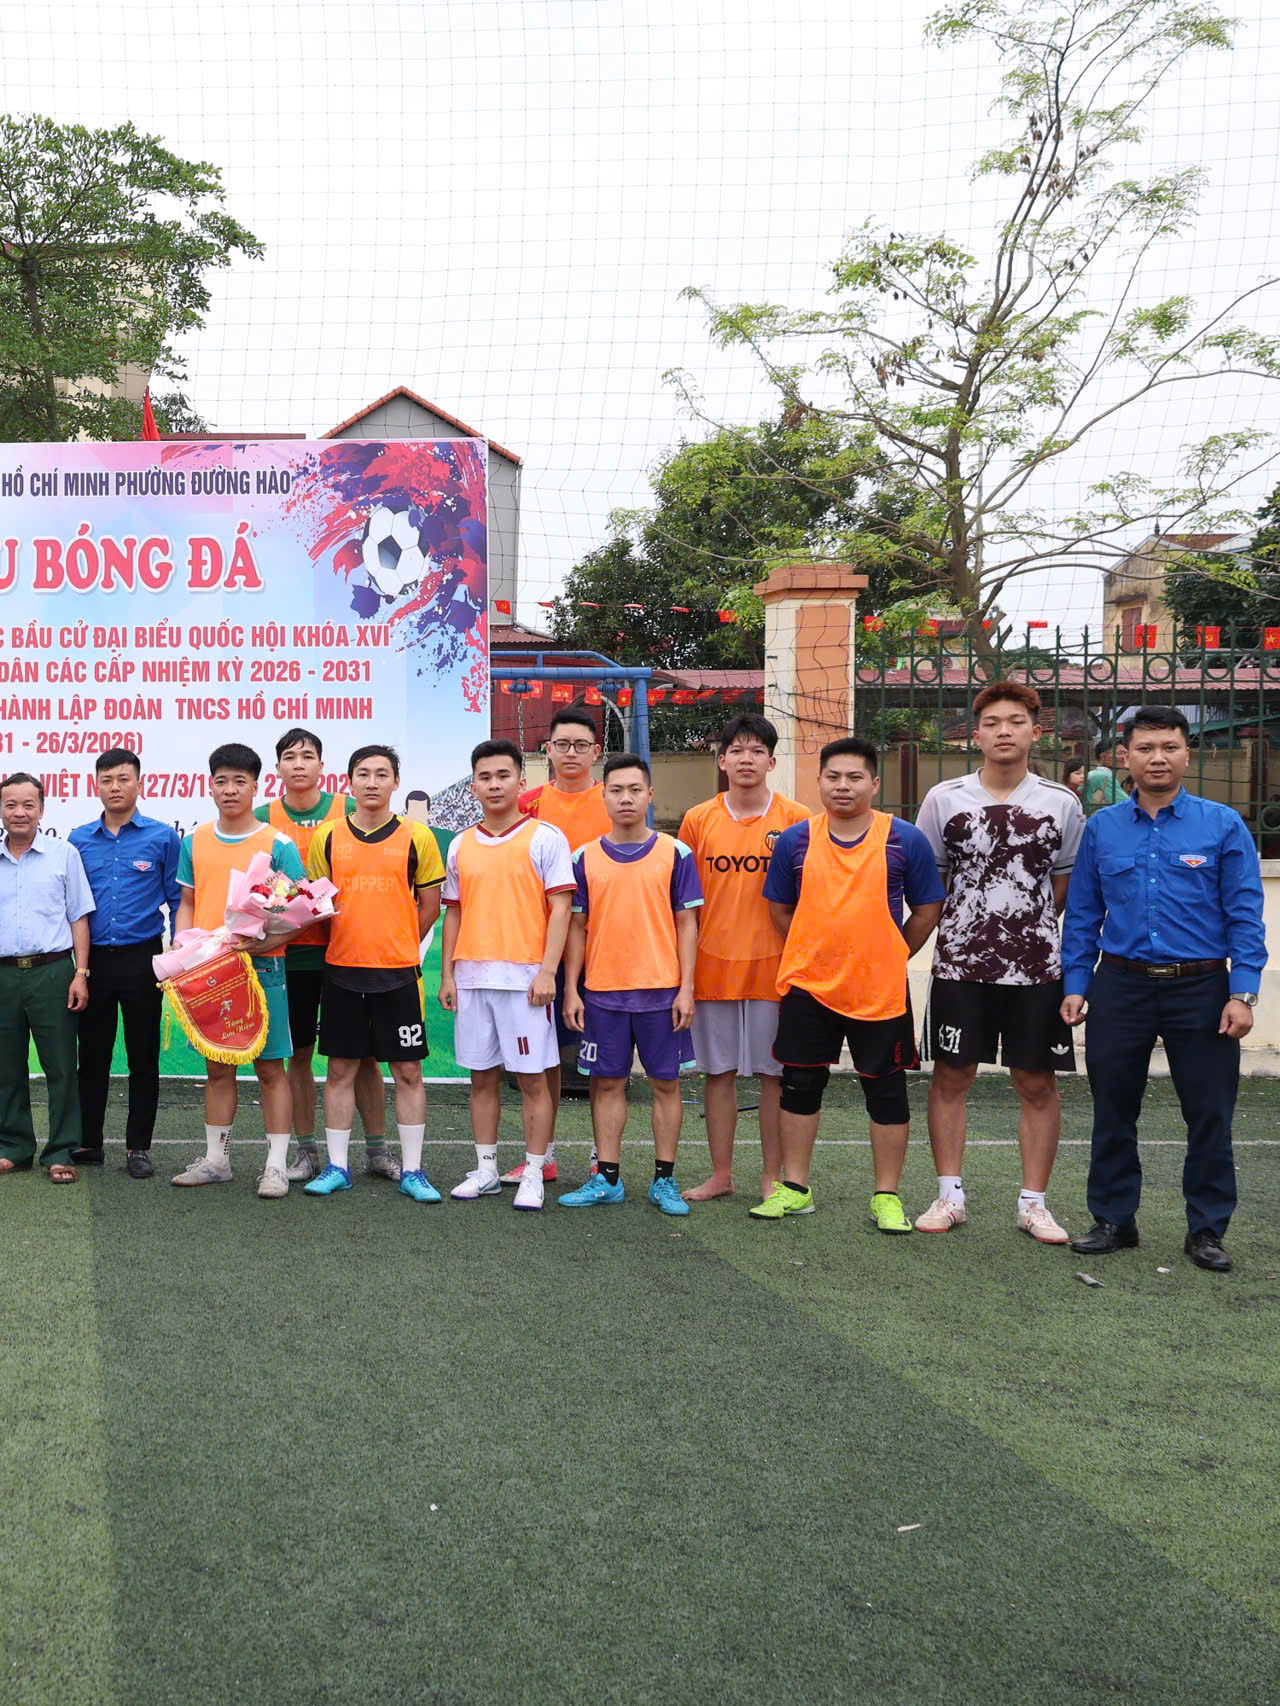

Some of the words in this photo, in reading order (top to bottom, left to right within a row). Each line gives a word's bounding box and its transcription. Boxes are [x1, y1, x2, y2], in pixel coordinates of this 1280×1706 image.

[1, 462, 24, 497] HỒ
[30, 467, 58, 497] CHÍ
[64, 472, 110, 497] MINH
[115, 465, 186, 496] PHƯỜNG
[190, 464, 250, 496] ĐƯỜNG
[256, 465, 291, 495] HÀO
[33, 523, 173, 590] BÓNG
[187, 521, 262, 589] ĐÁ
[11, 619, 53, 649] BẦU
[59, 618, 89, 649] CỬ
[93, 626, 128, 654] ĐẠI
[135, 616, 182, 649] BIỂU
[189, 617, 245, 650] QUỐC
[251, 621, 286, 654] HỘI
[293, 620, 350, 648] KHÓA
[356, 624, 390, 647] XVI
[46, 657, 87, 684] CÁC
[95, 653, 136, 683] CẤP
[143, 655, 211, 688] NHIỆM
[217, 655, 244, 682] KỲ
[251, 660, 301, 683] 2026
[323, 659, 371, 682] 2031
[58, 694, 97, 727] LẬP
[103, 693, 163, 721] ĐOÀN
[175, 697, 231, 721] TNCS
[237, 690, 265, 721] HỒ
[273, 693, 309, 720] CHÍ
[315, 697, 373, 720] MINH
[36, 731, 143, 754] 26/3/2026)
[43, 768, 80, 802] VIỆT
[705, 855, 771, 873] TOYOT
[397, 1024, 423, 1047] 92
[579, 1040, 598, 1063] 20
